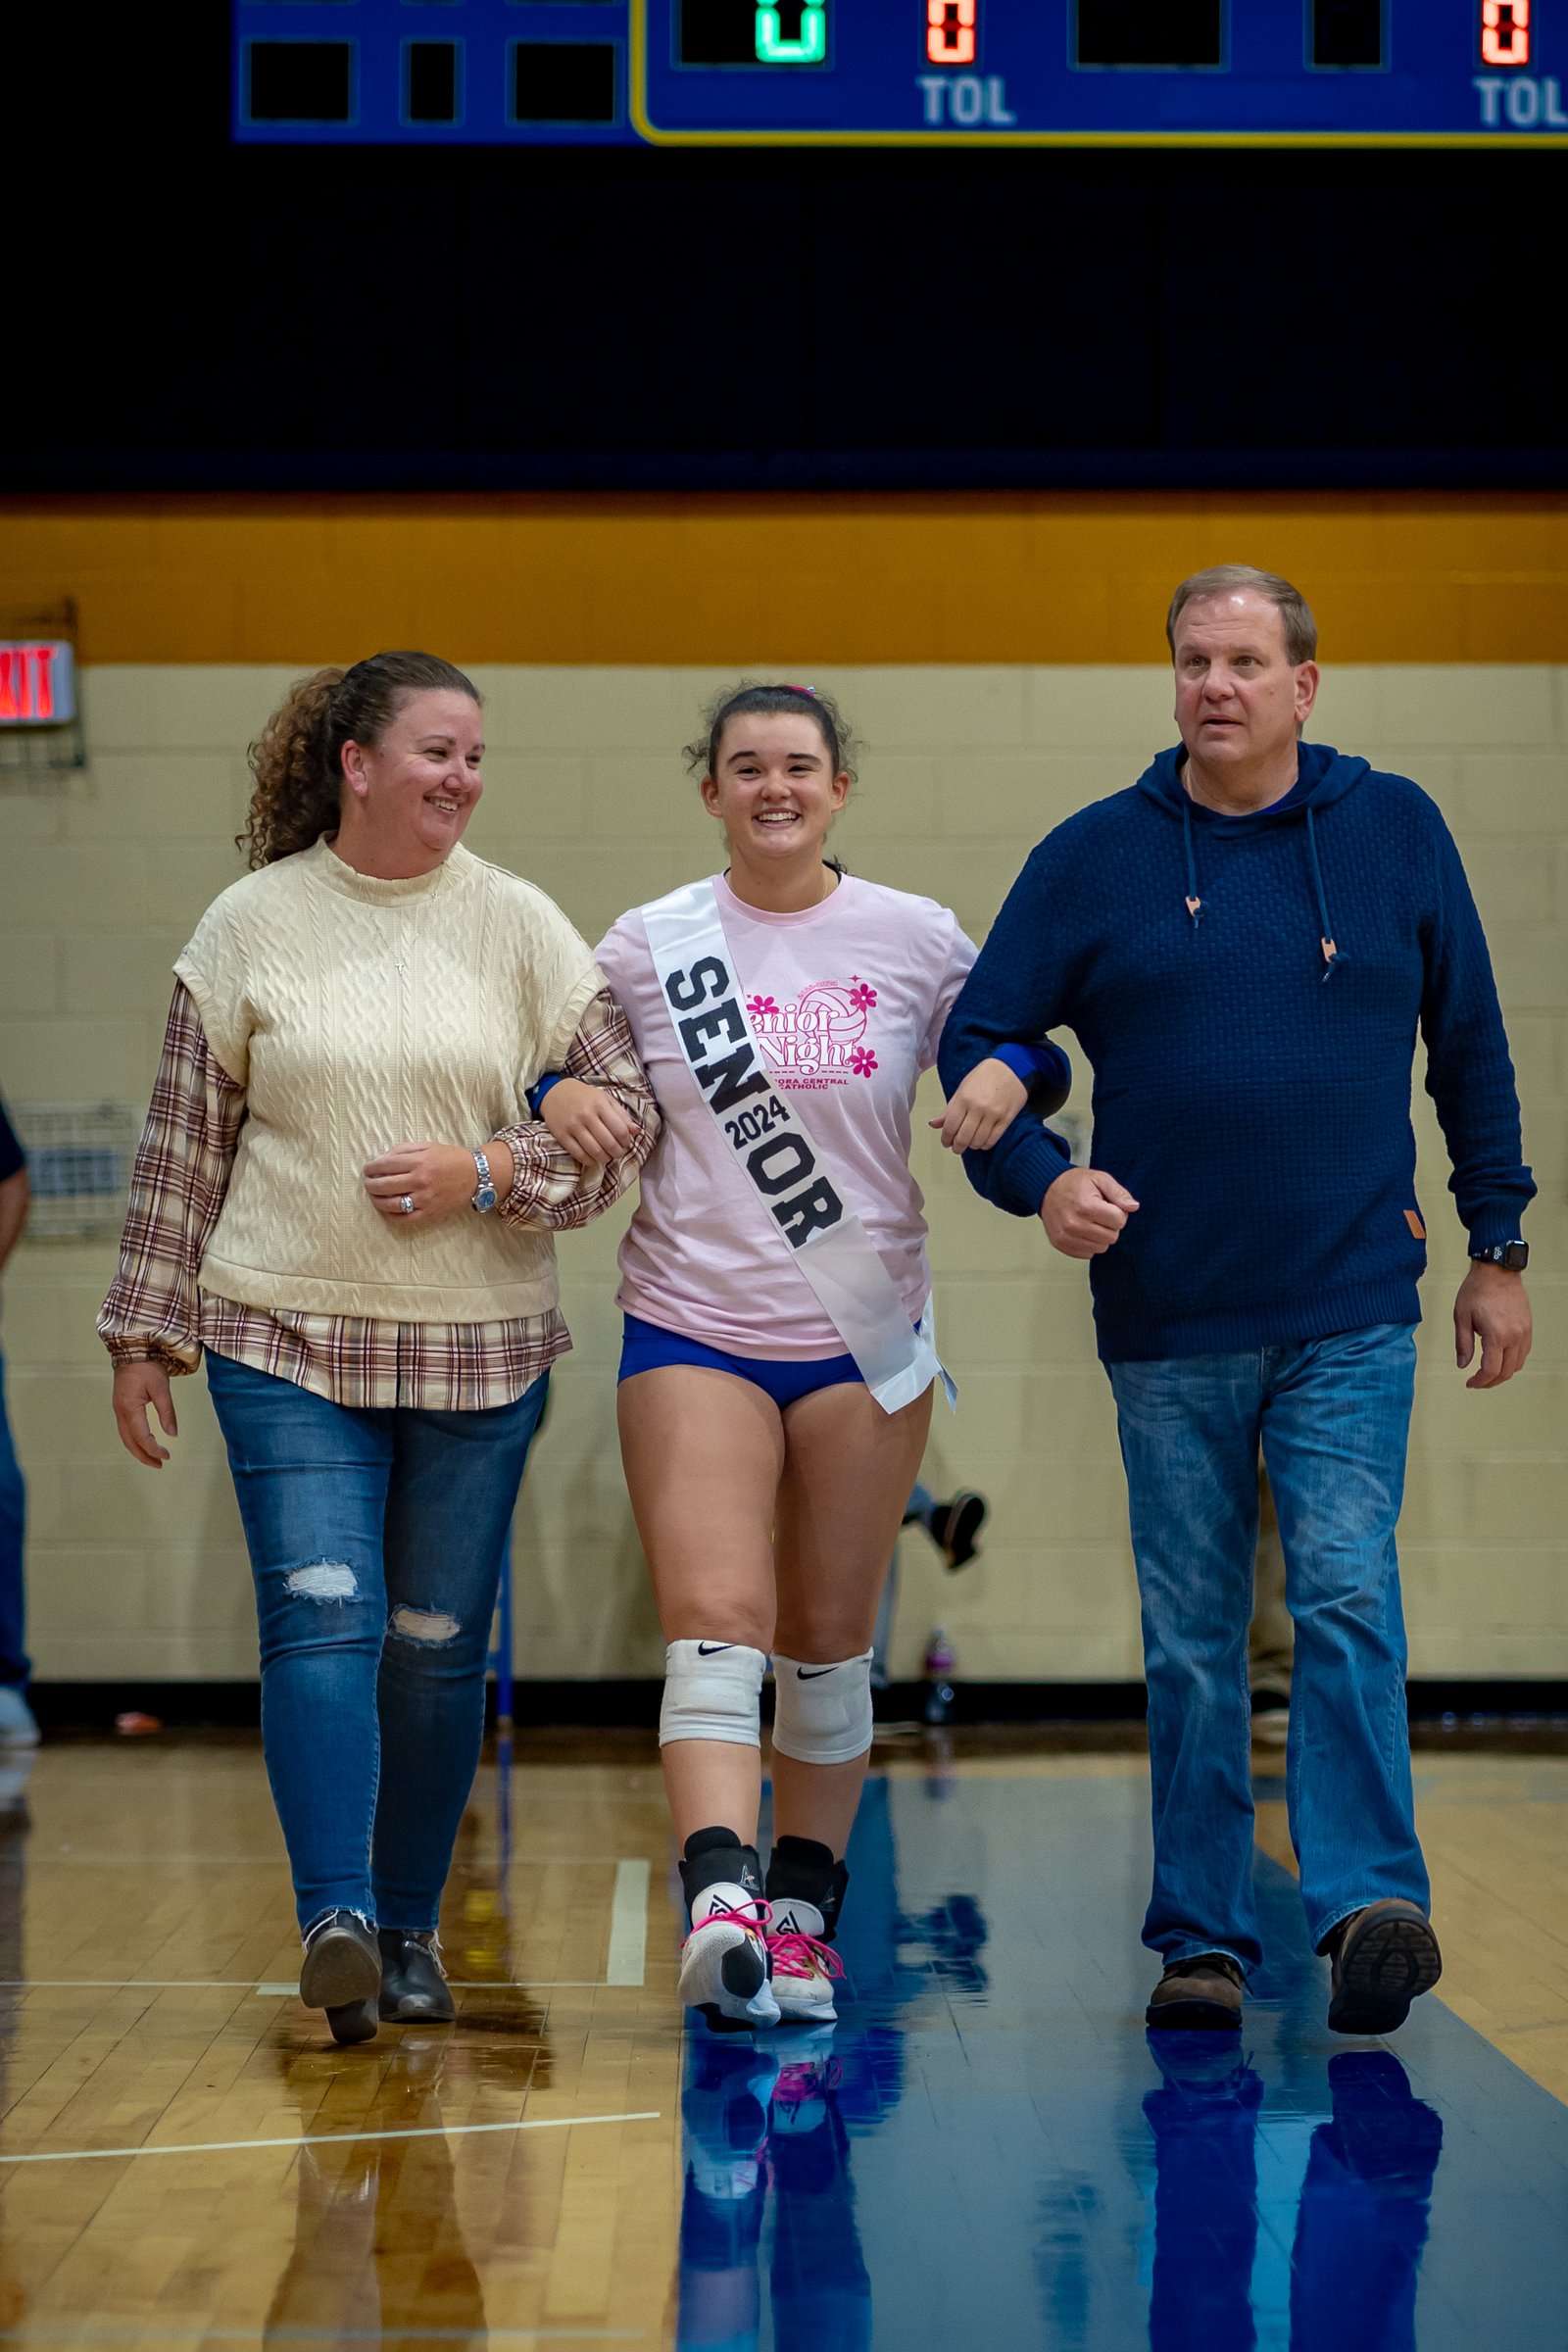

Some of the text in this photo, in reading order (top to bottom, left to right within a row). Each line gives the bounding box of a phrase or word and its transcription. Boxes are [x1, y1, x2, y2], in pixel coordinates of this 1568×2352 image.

[917, 75, 1016, 125] TOL
[1473, 76, 1568, 126] TOL
[748, 1003, 840, 1034] enior
[756, 1035, 856, 1076] Night
[724, 1095, 791, 1151] 2024
